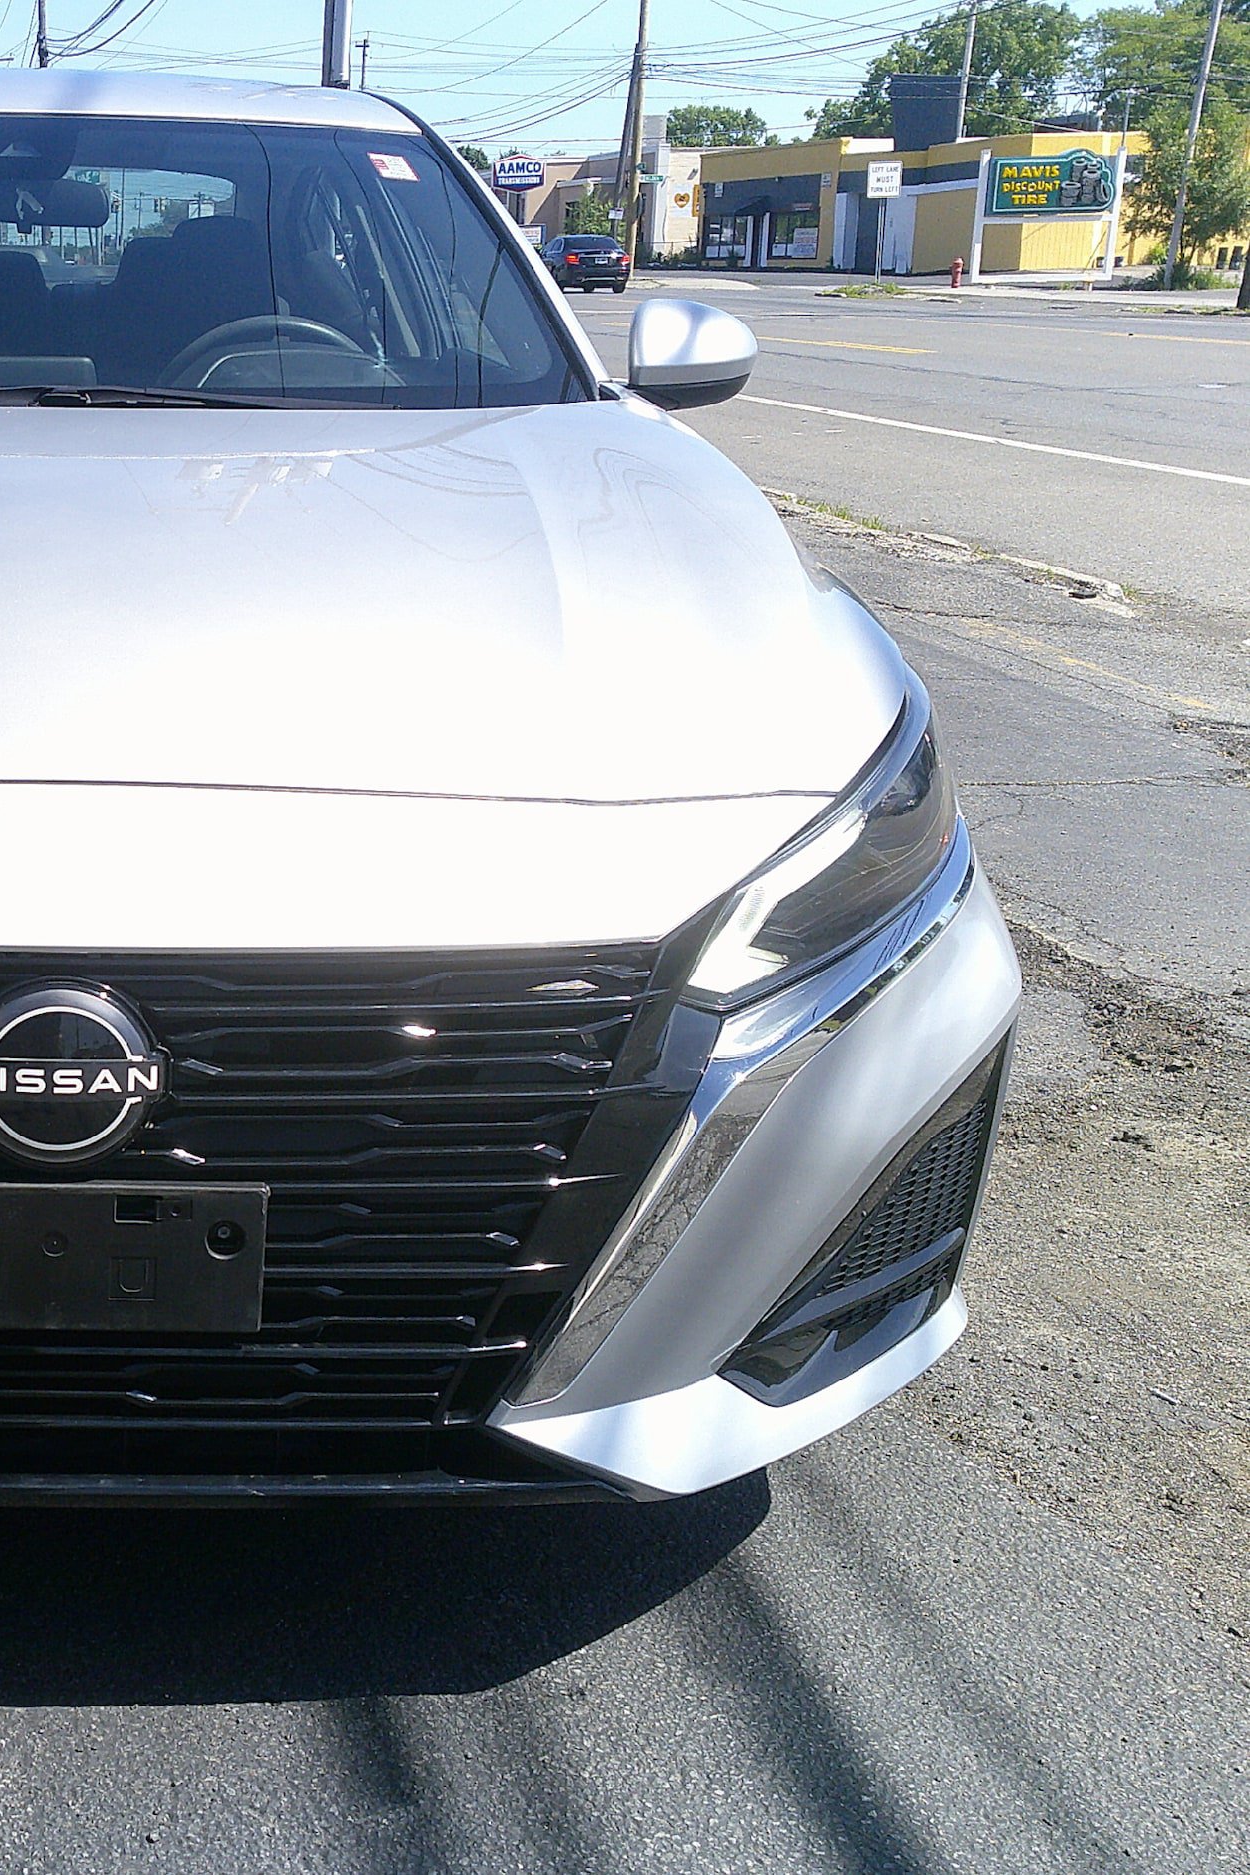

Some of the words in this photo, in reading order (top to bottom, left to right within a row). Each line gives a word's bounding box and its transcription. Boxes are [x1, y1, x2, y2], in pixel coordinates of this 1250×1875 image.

[498, 161, 541, 174] AAMCO
[1002, 165, 1060, 178] MAVIS
[1002, 180, 1061, 192] DISCOUNT
[1012, 194, 1048, 205] TIRE
